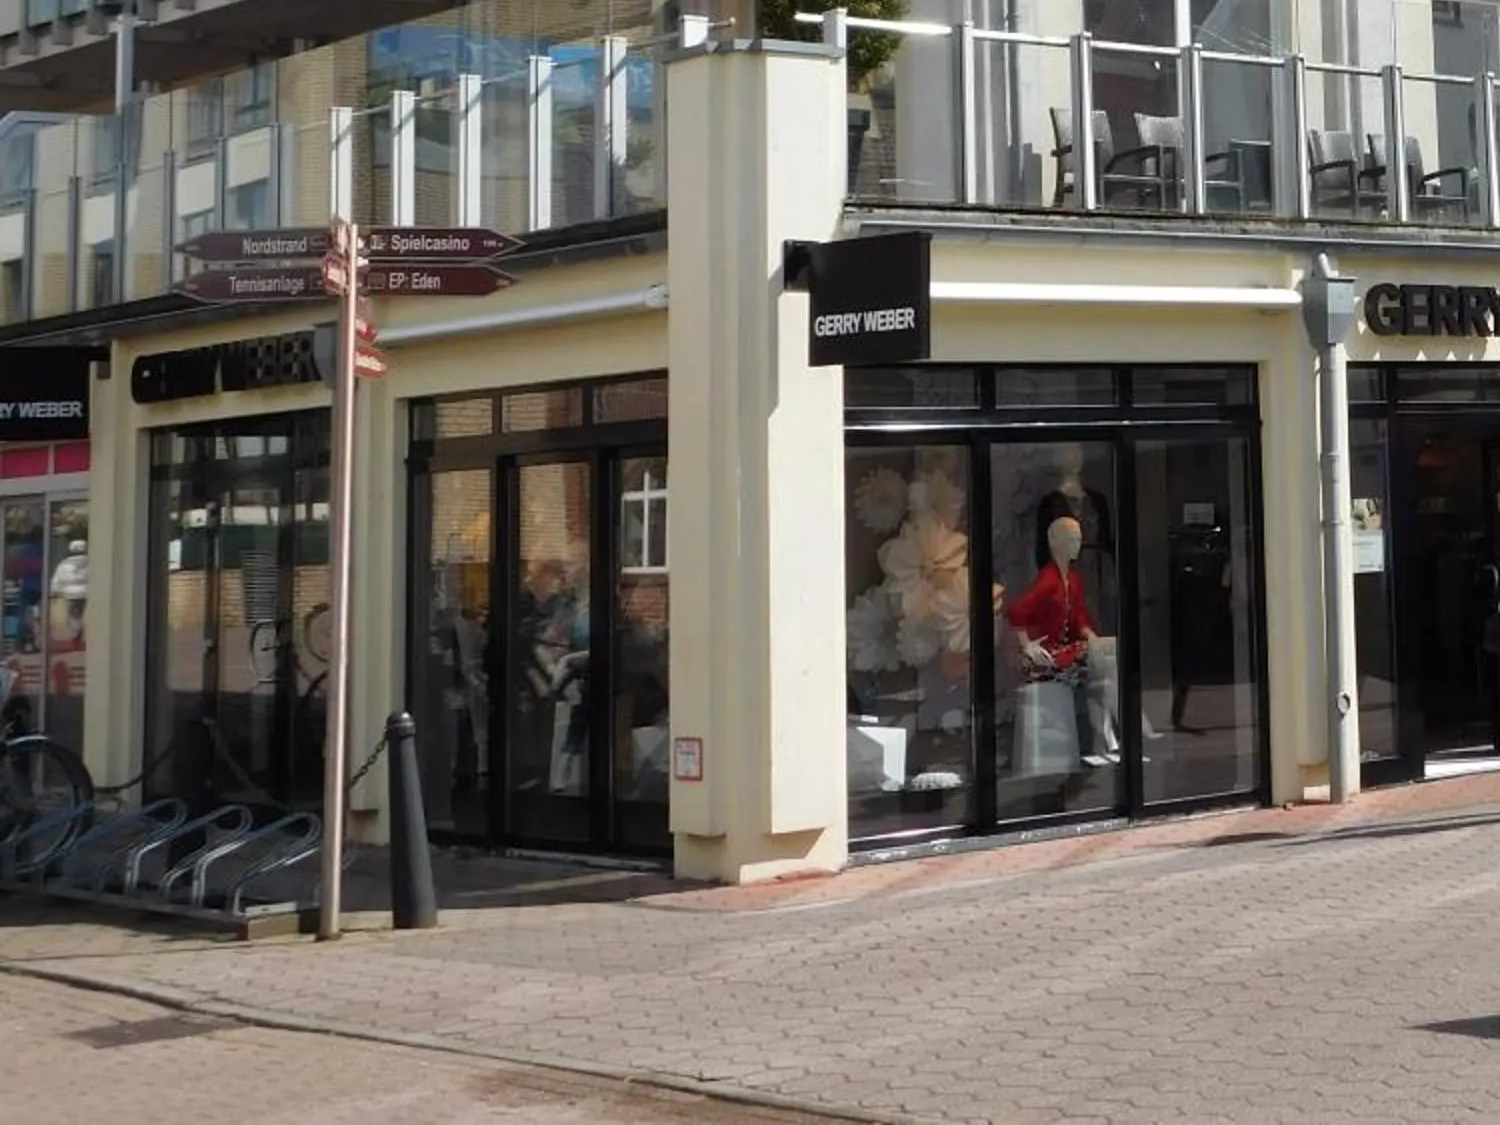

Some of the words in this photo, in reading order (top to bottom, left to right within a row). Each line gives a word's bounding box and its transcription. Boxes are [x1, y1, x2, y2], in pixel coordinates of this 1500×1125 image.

[243, 237, 307, 254] Nordstrand
[391, 234, 470, 254] Spielcasino
[229, 276, 304, 295] Tennisanlage
[411, 272, 441, 289] Eden
[815, 312, 862, 336] GERRY
[864, 307, 915, 332] WEBER
[19, 401, 83, 418] WEBER
